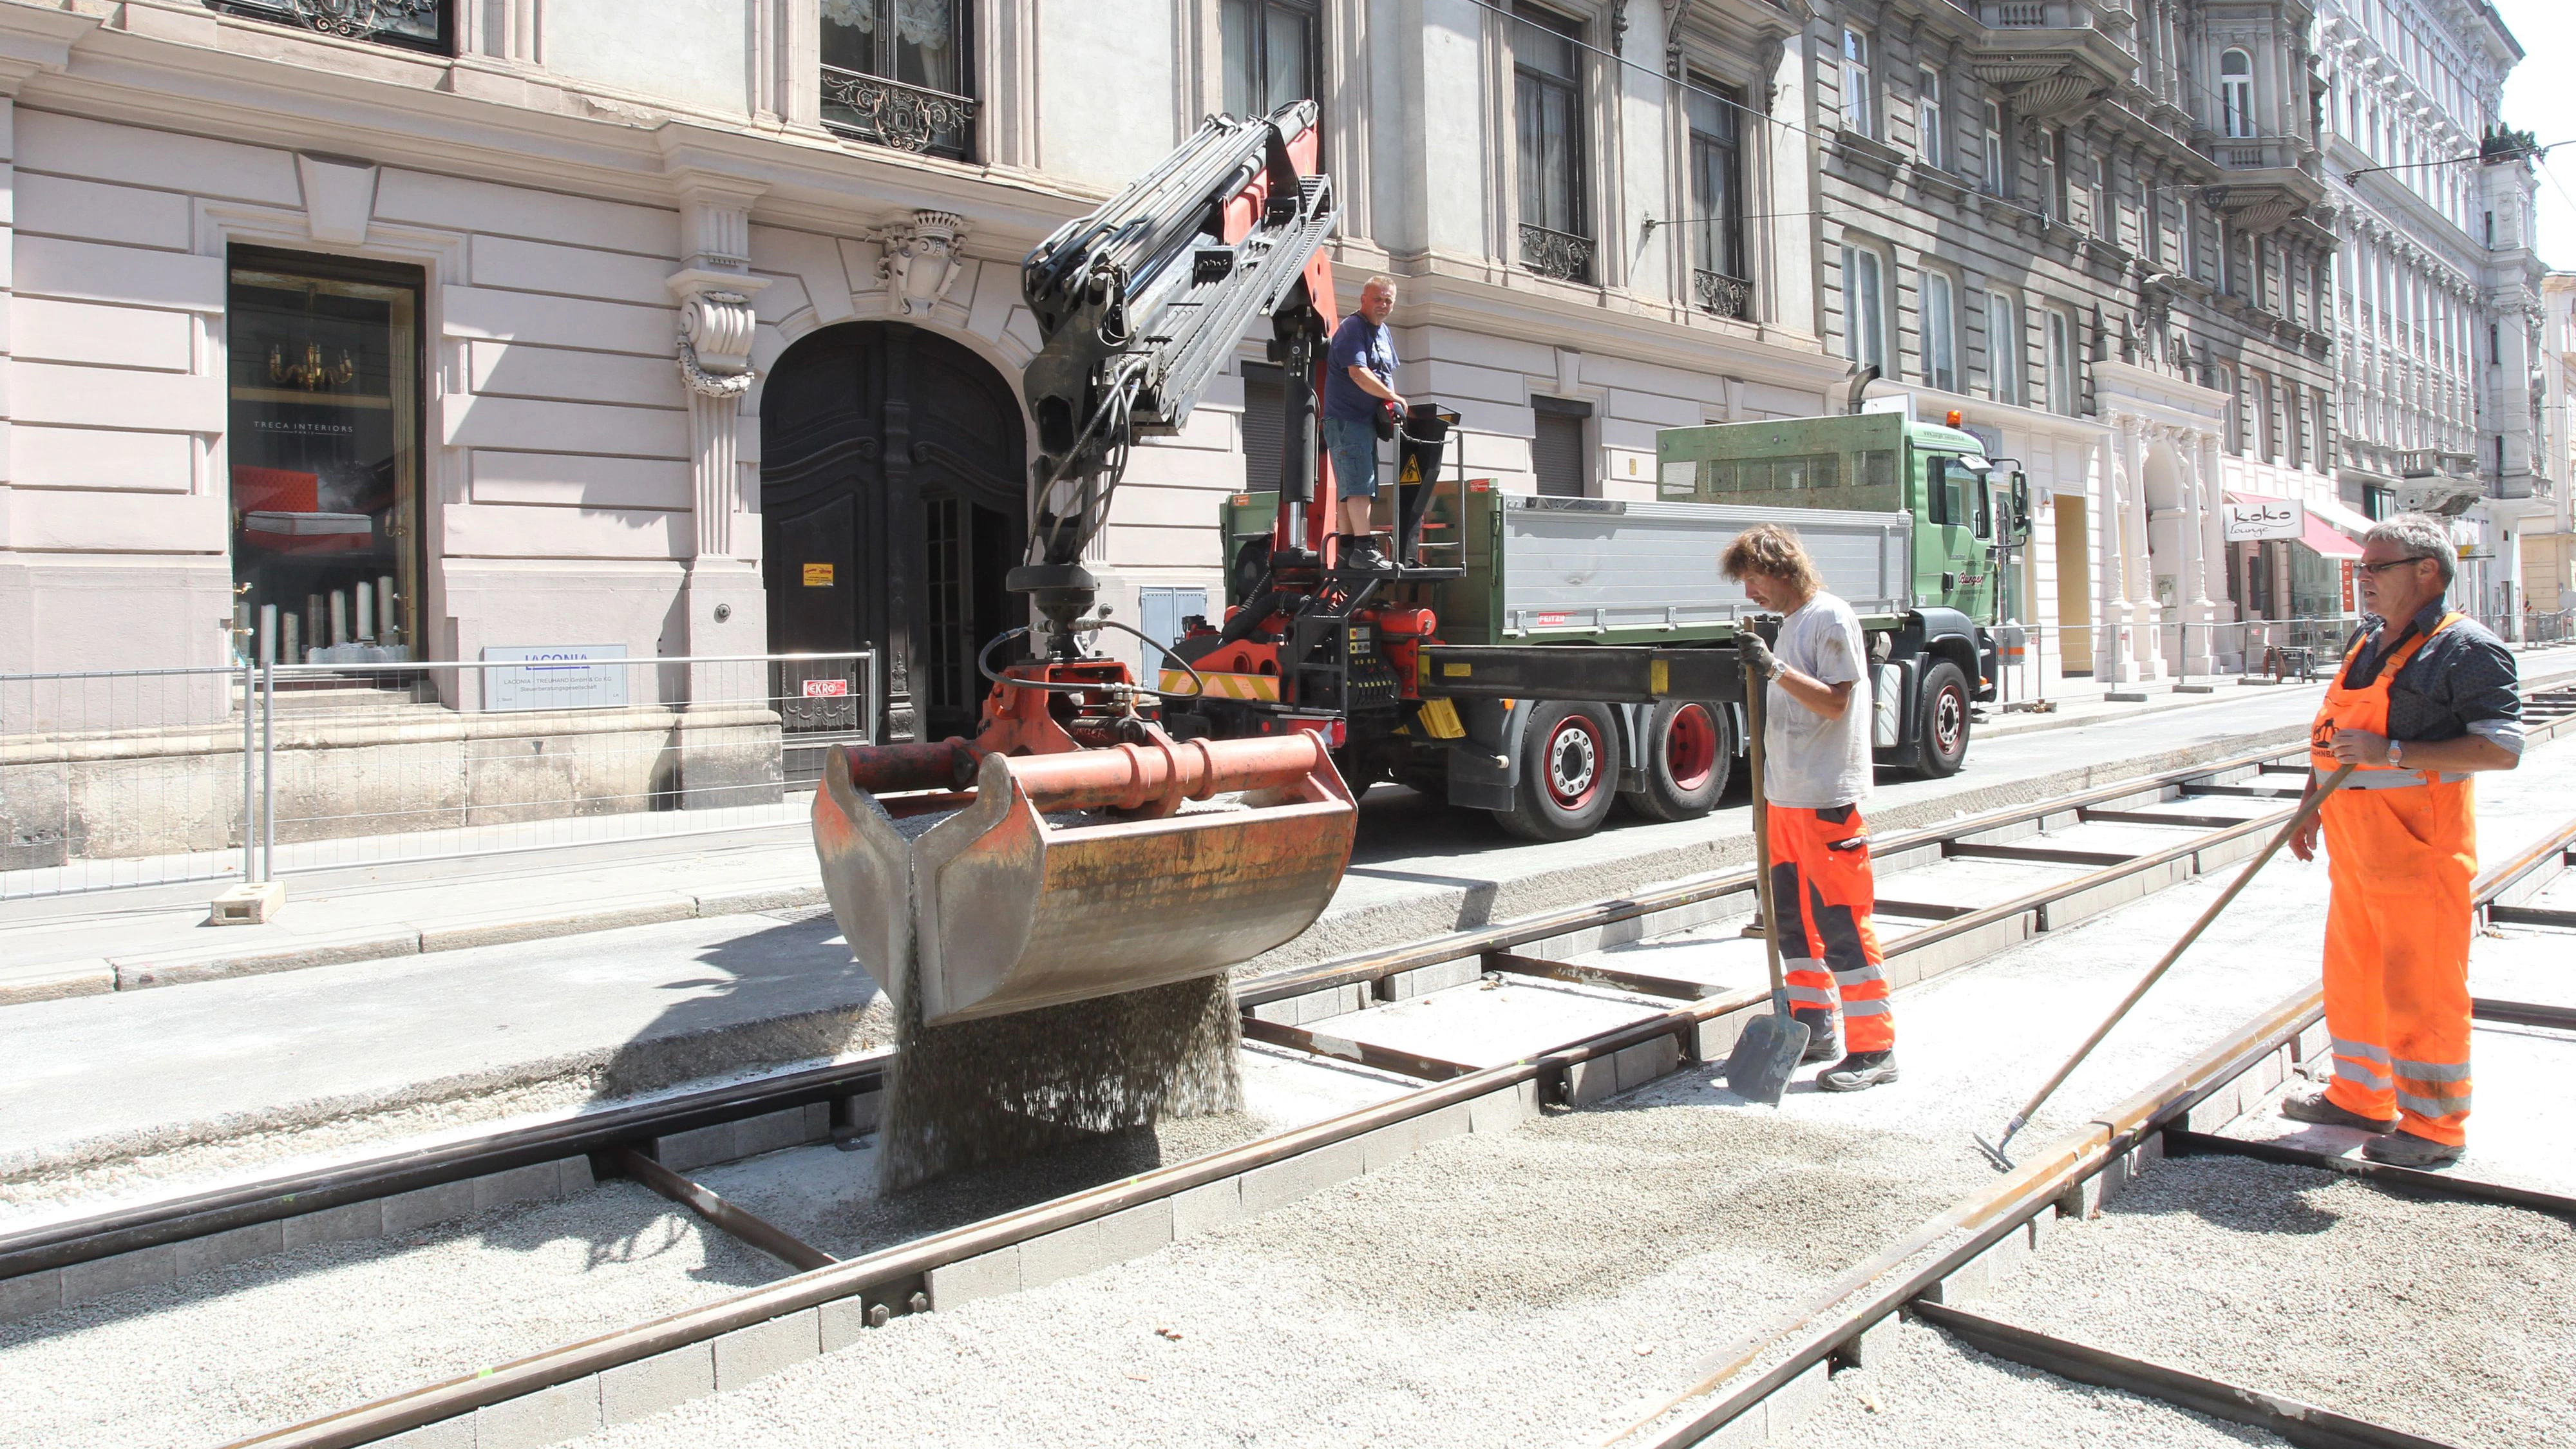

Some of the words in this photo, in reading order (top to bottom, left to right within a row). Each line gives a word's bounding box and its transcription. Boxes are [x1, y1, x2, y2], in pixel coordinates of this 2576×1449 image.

[253, 421, 289, 429] TRECA
[294, 423, 353, 432] INTERIORS
[809, 683, 835, 695] EKRO
